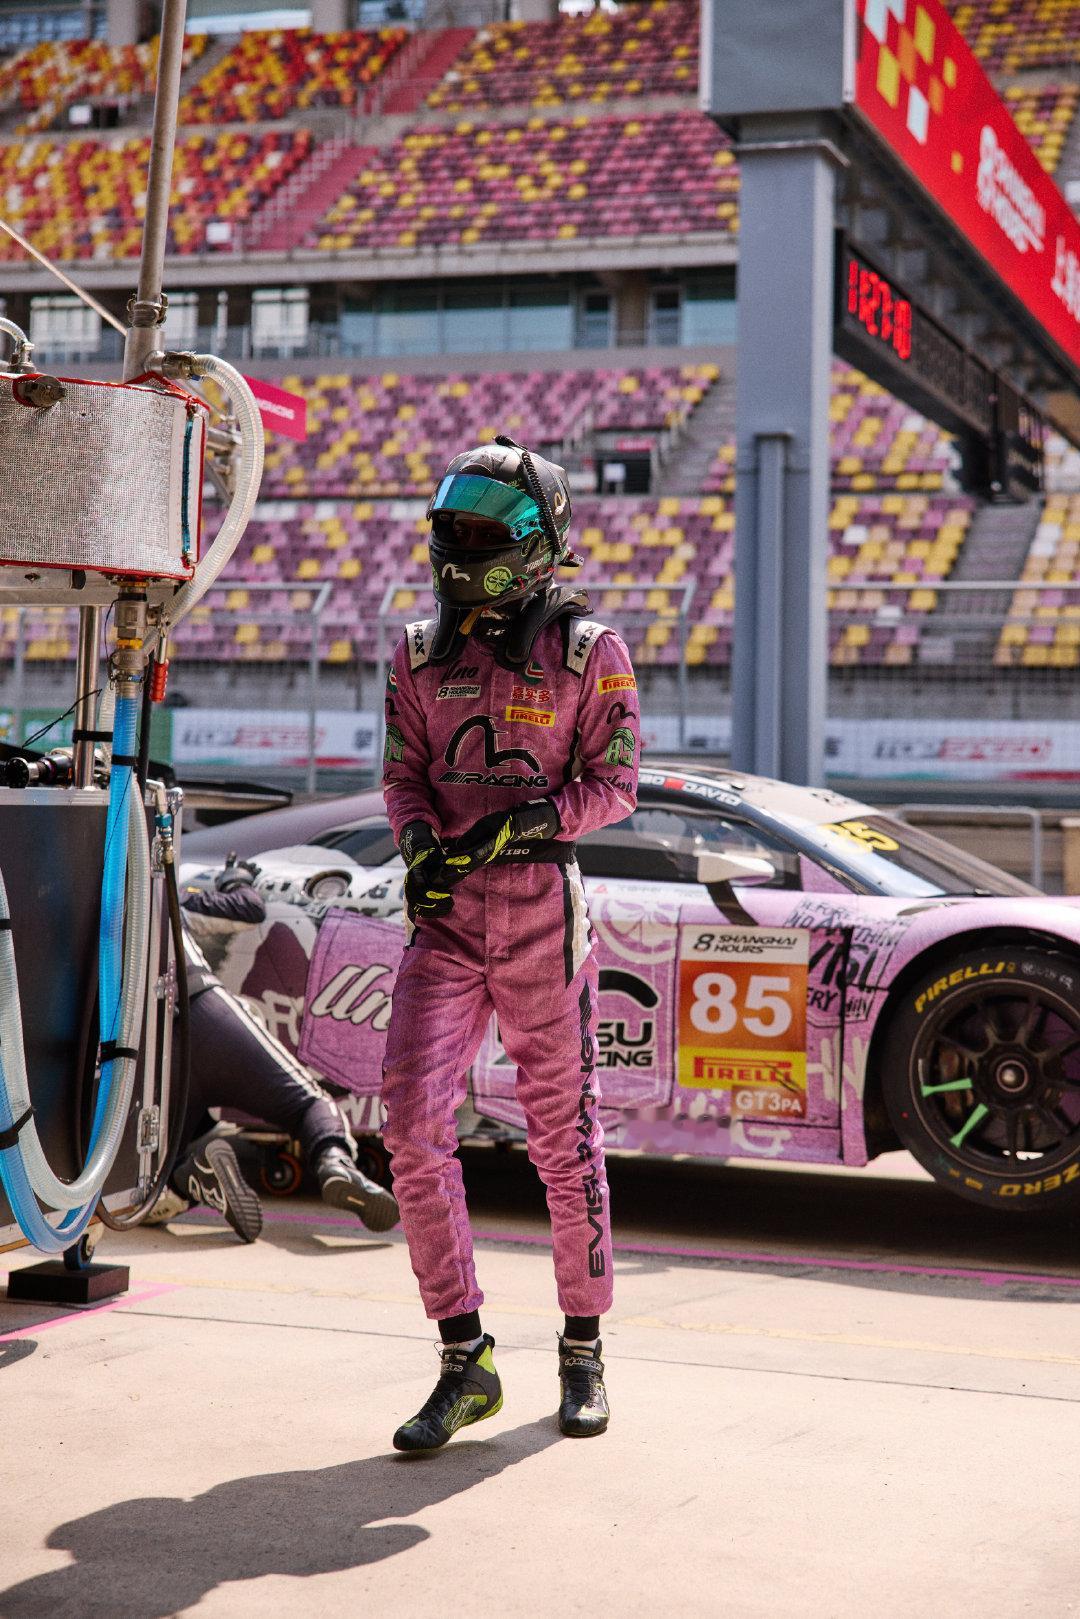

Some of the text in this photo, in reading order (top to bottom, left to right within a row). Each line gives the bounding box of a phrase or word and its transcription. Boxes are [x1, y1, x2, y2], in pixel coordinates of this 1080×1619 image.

[512, 686, 550, 702] 嘉实多
[510, 709, 551, 725] PIRELLI
[462, 771, 550, 789] RACING
[682, 780, 743, 807] DAVID
[693, 934, 798, 952] 8 SHANGHAI
[713, 944, 765, 955] HOURS
[912, 961, 1005, 1014] PIRELLI
[689, 971, 793, 1038] 85
[694, 1056, 793, 1084] PIRELLI
[999, 1162, 1080, 1197] ZERO
